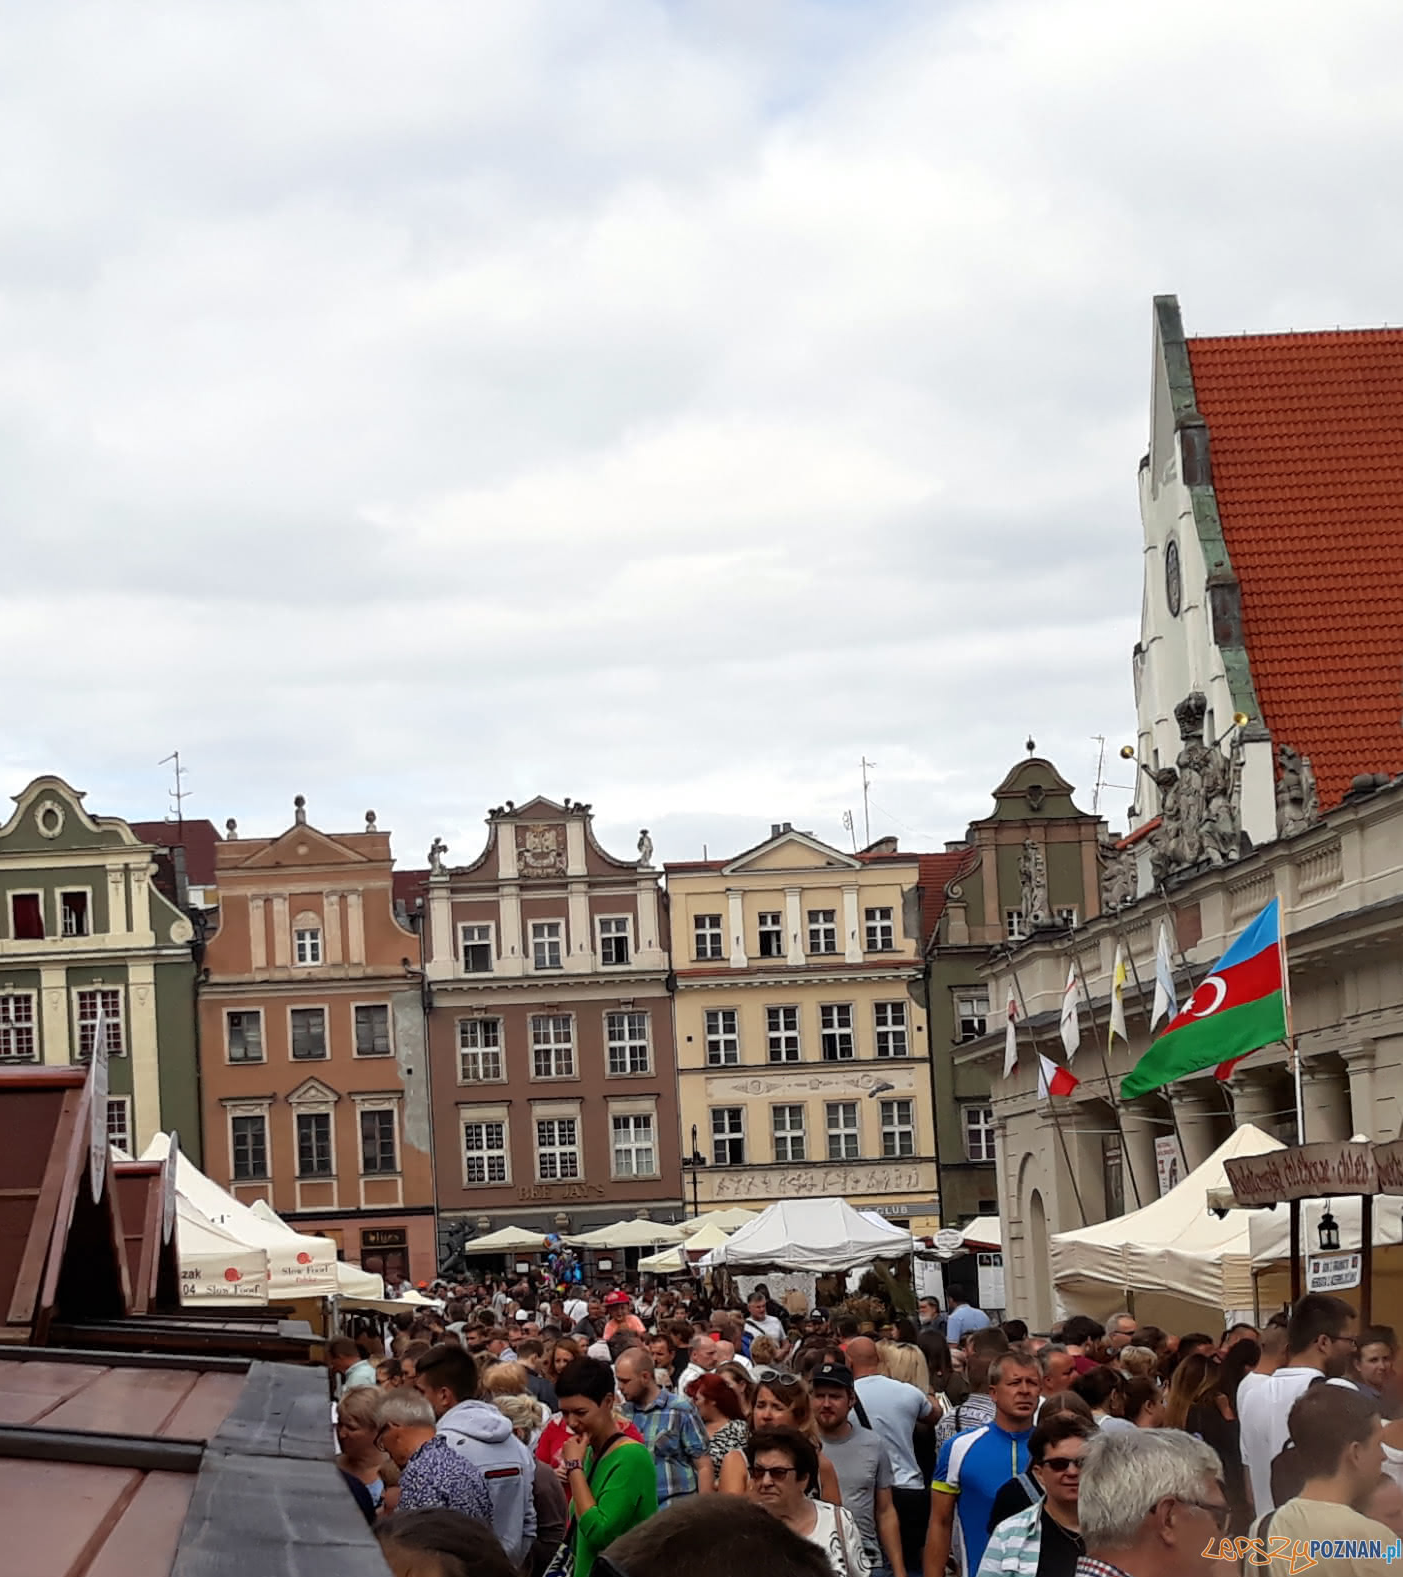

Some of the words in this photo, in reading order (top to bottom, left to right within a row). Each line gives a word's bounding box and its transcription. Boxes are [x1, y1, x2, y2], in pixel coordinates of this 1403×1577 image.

[518, 1185, 552, 1200] BEE
[563, 1184, 605, 1199] JAY'S
[877, 1206, 908, 1215] CLUB
[181, 1268, 202, 1279] zak
[306, 1265, 328, 1274] Food
[183, 1284, 196, 1295] 04
[205, 1285, 229, 1296] Slow
[234, 1284, 261, 1295] Food
